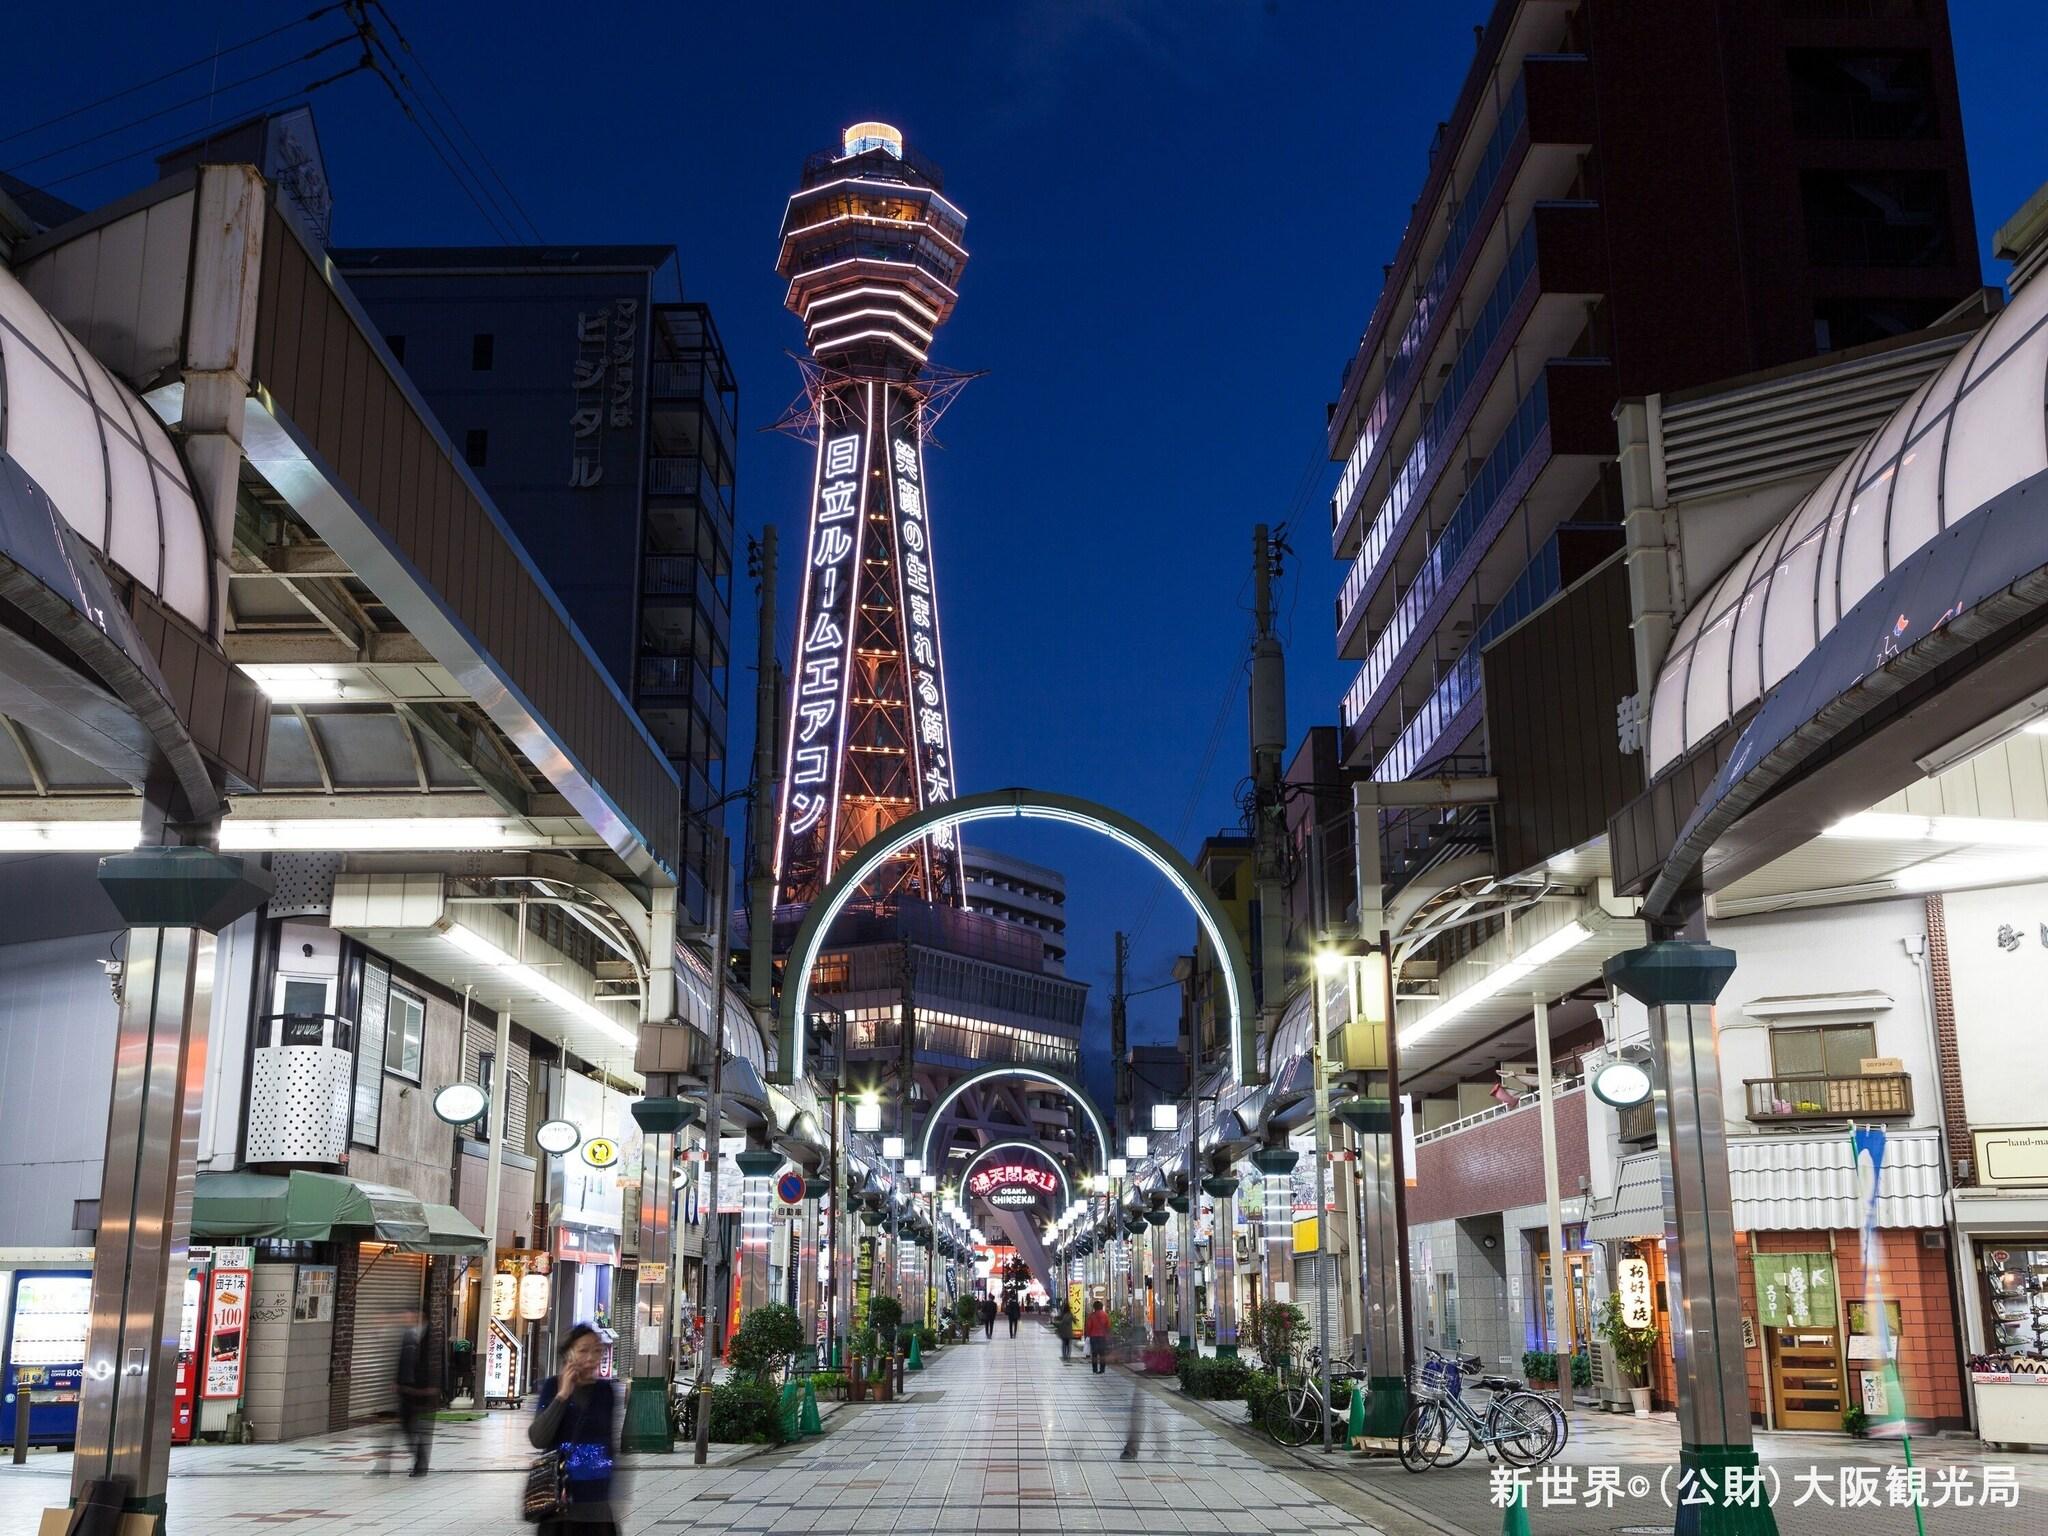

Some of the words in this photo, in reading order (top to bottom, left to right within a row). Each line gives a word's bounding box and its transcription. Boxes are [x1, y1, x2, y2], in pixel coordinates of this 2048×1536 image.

[610, 298, 638, 427] マンションは
[790, 434, 859, 835] 日立ルームエアコン
[970, 1165, 1057, 1192] 通天閣本通
[992, 1196, 1035, 1205] SHINSEKAI
[1001, 1187, 1027, 1195] OSAKA
[778, 1207, 802, 1216] 自動車
[216, 1279, 246, 1291] 団子1本
[1629, 1265, 1648, 1321] お好み焼
[1766, 1284, 1777, 1319] スワロー
[214, 1308, 242, 1326] ¥100
